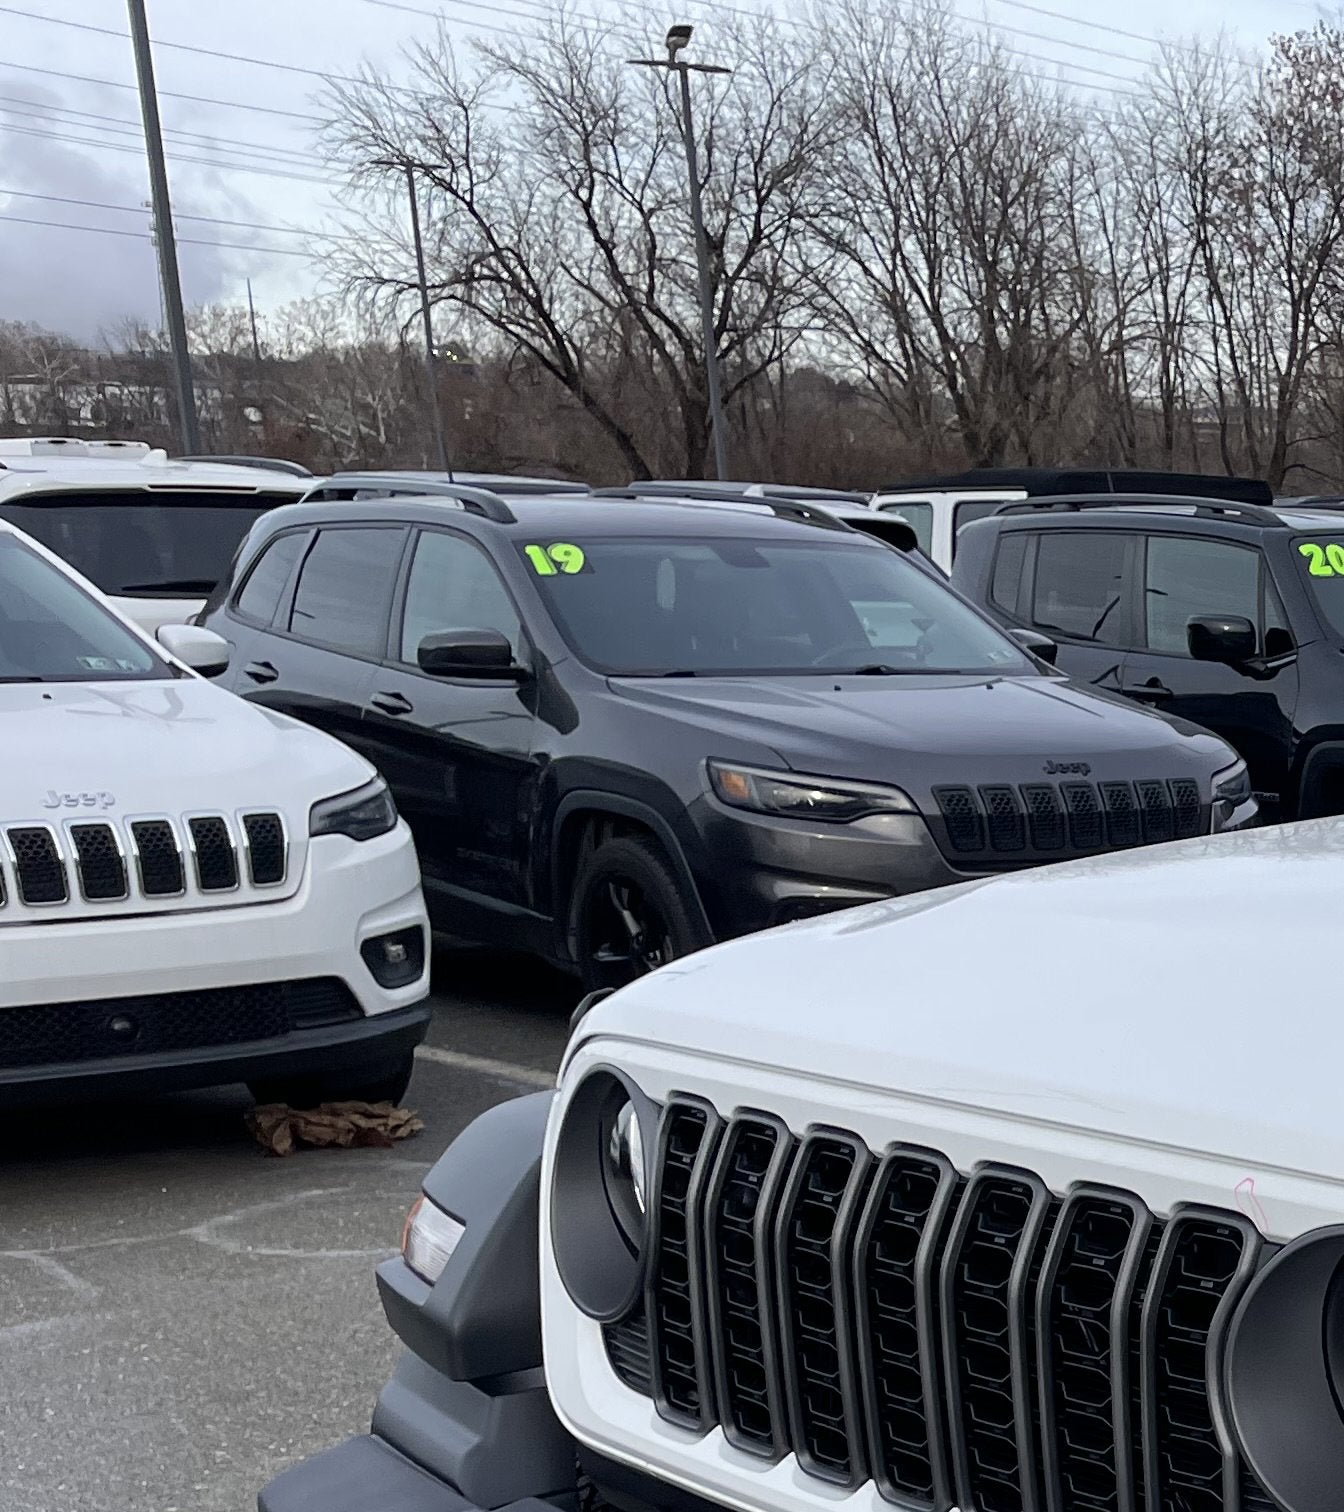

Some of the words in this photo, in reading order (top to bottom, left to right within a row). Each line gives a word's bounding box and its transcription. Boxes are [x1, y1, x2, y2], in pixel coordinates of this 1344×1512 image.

[524, 542, 585, 575] 19
[1042, 759, 1092, 777] Jeep
[41, 789, 116, 810] Jeep
